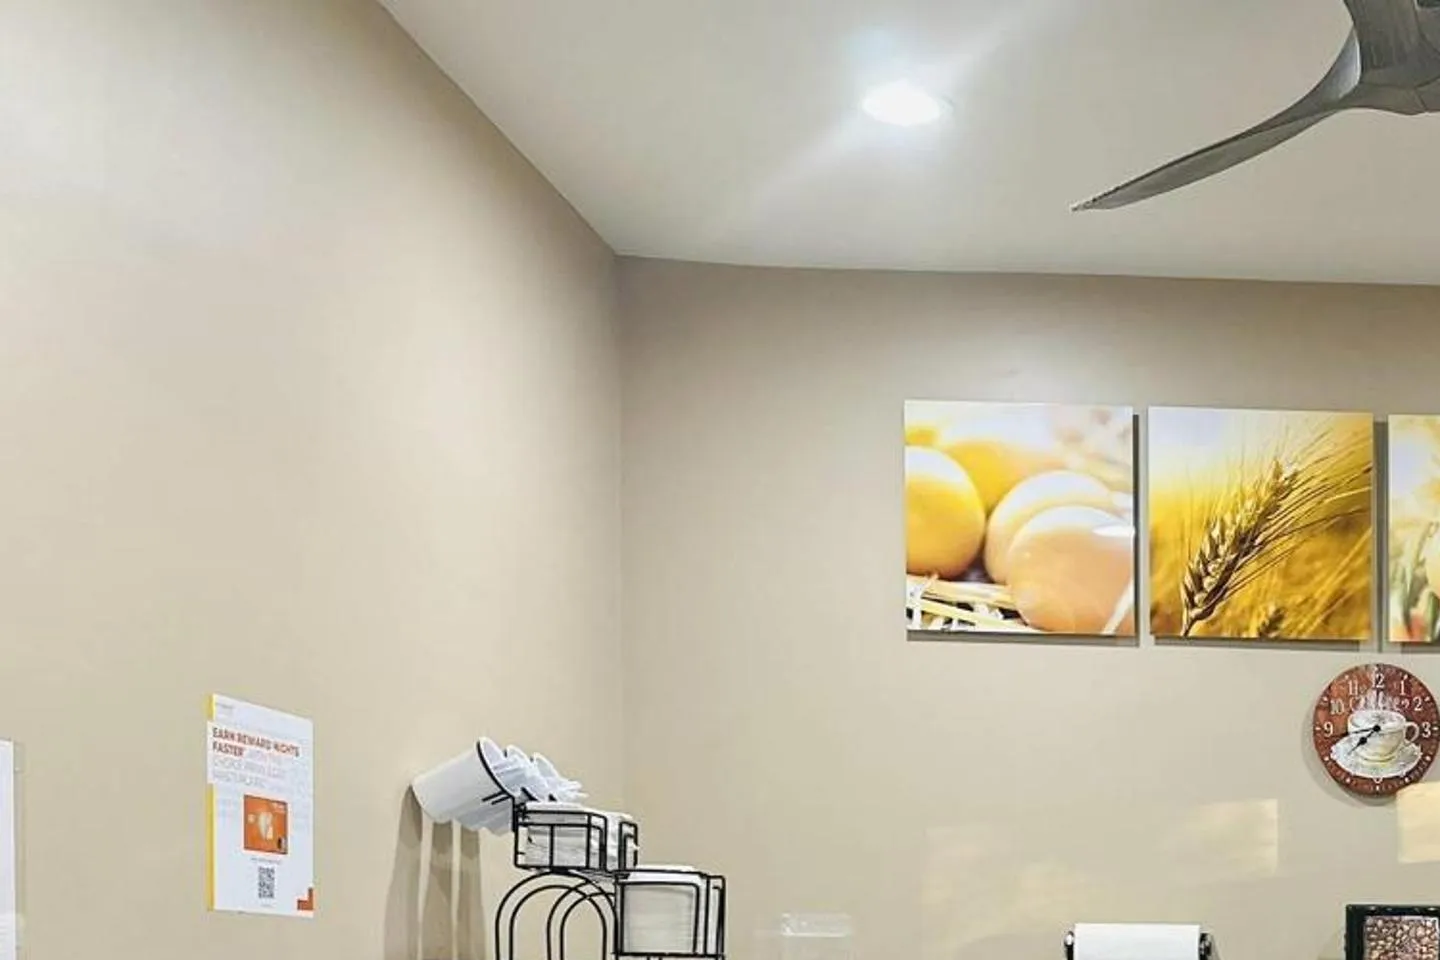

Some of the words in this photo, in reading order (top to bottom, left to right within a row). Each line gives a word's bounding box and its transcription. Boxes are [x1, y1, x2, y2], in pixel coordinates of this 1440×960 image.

[1347, 680, 1359, 696] 11
[1399, 680, 1407, 696] 1
[1413, 696, 1423, 712] 2
[1323, 721, 1334, 738] 9
[1421, 721, 1432, 738] 3
